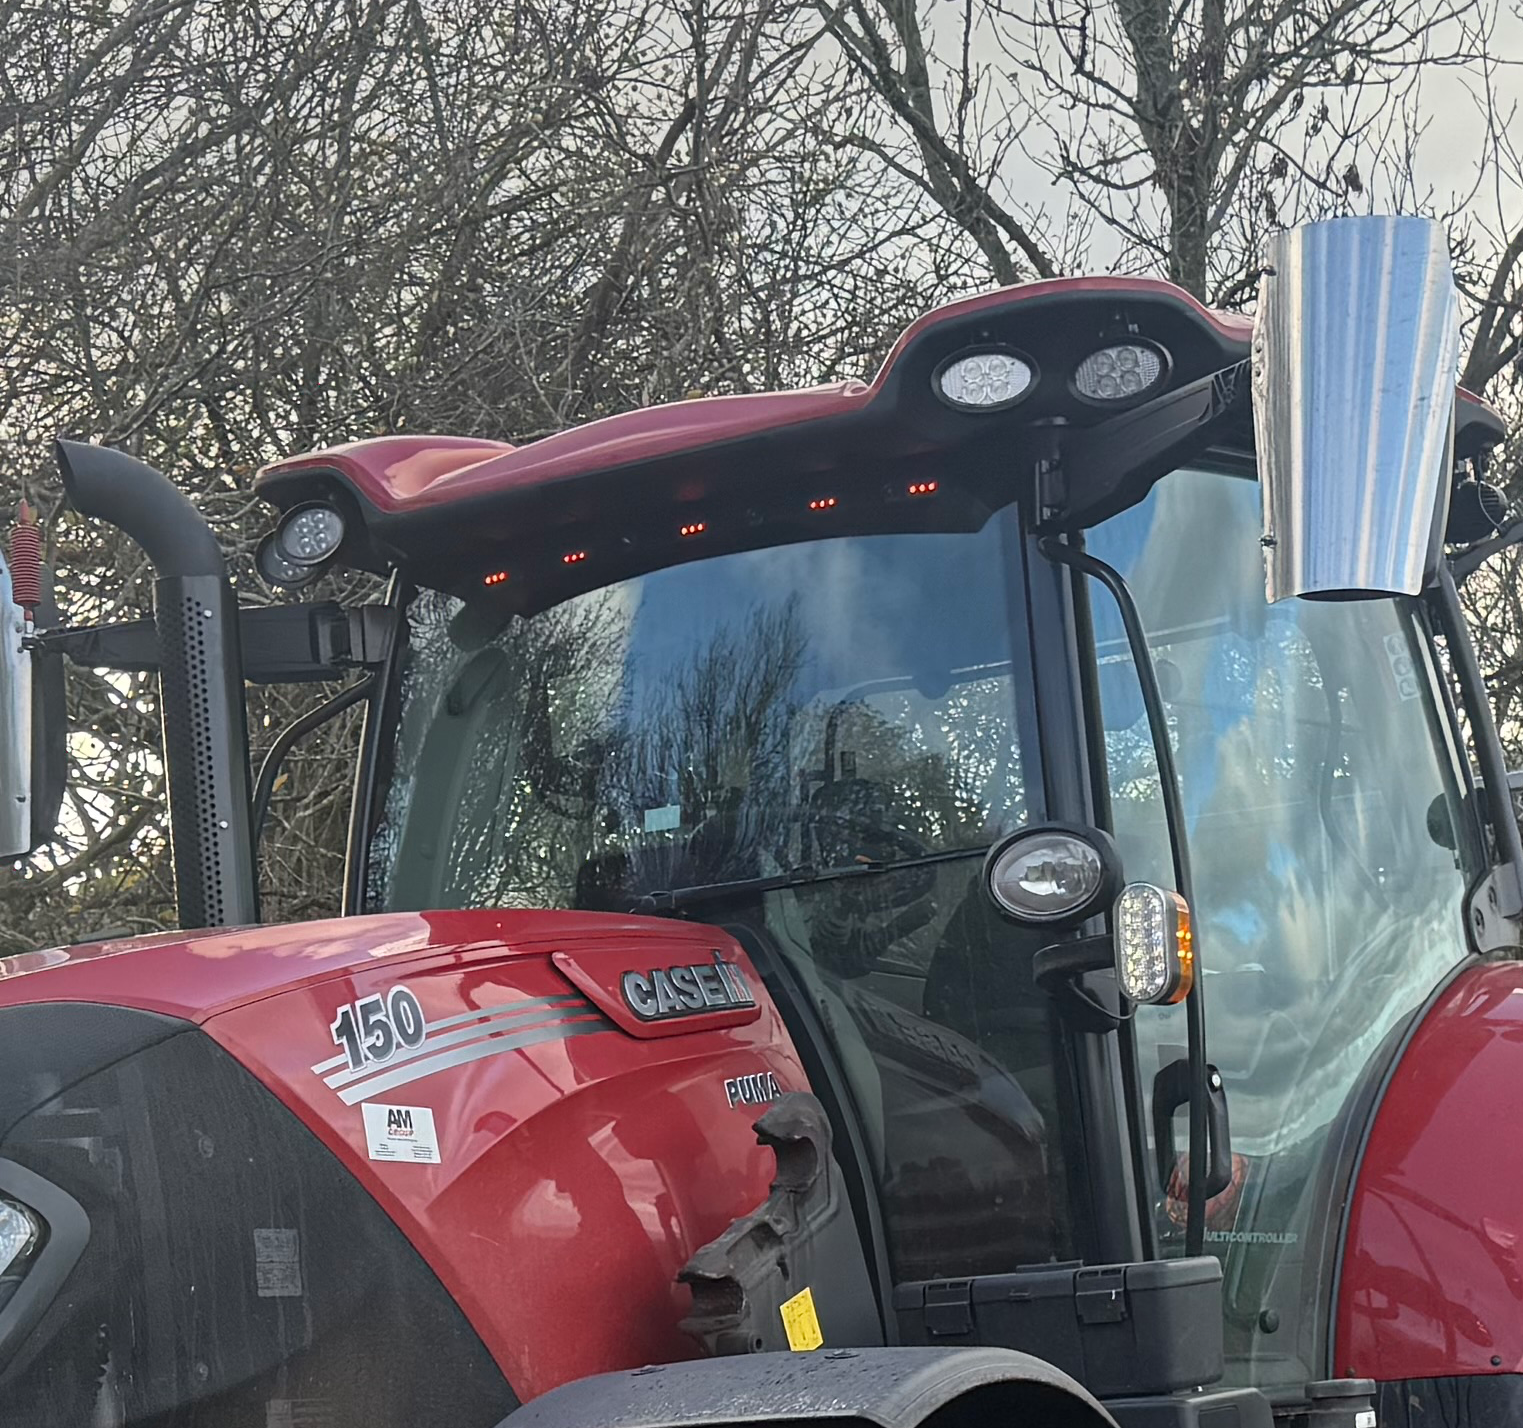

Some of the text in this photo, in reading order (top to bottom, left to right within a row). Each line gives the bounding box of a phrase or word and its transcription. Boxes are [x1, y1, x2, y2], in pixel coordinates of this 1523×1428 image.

[623, 964, 726, 1016] CASE
[330, 985, 426, 1073] 150
[724, 1072, 782, 1108] PUMA
[387, 1108, 413, 1129] AM
[1203, 1228, 1298, 1243] ULTICONTROLLER
